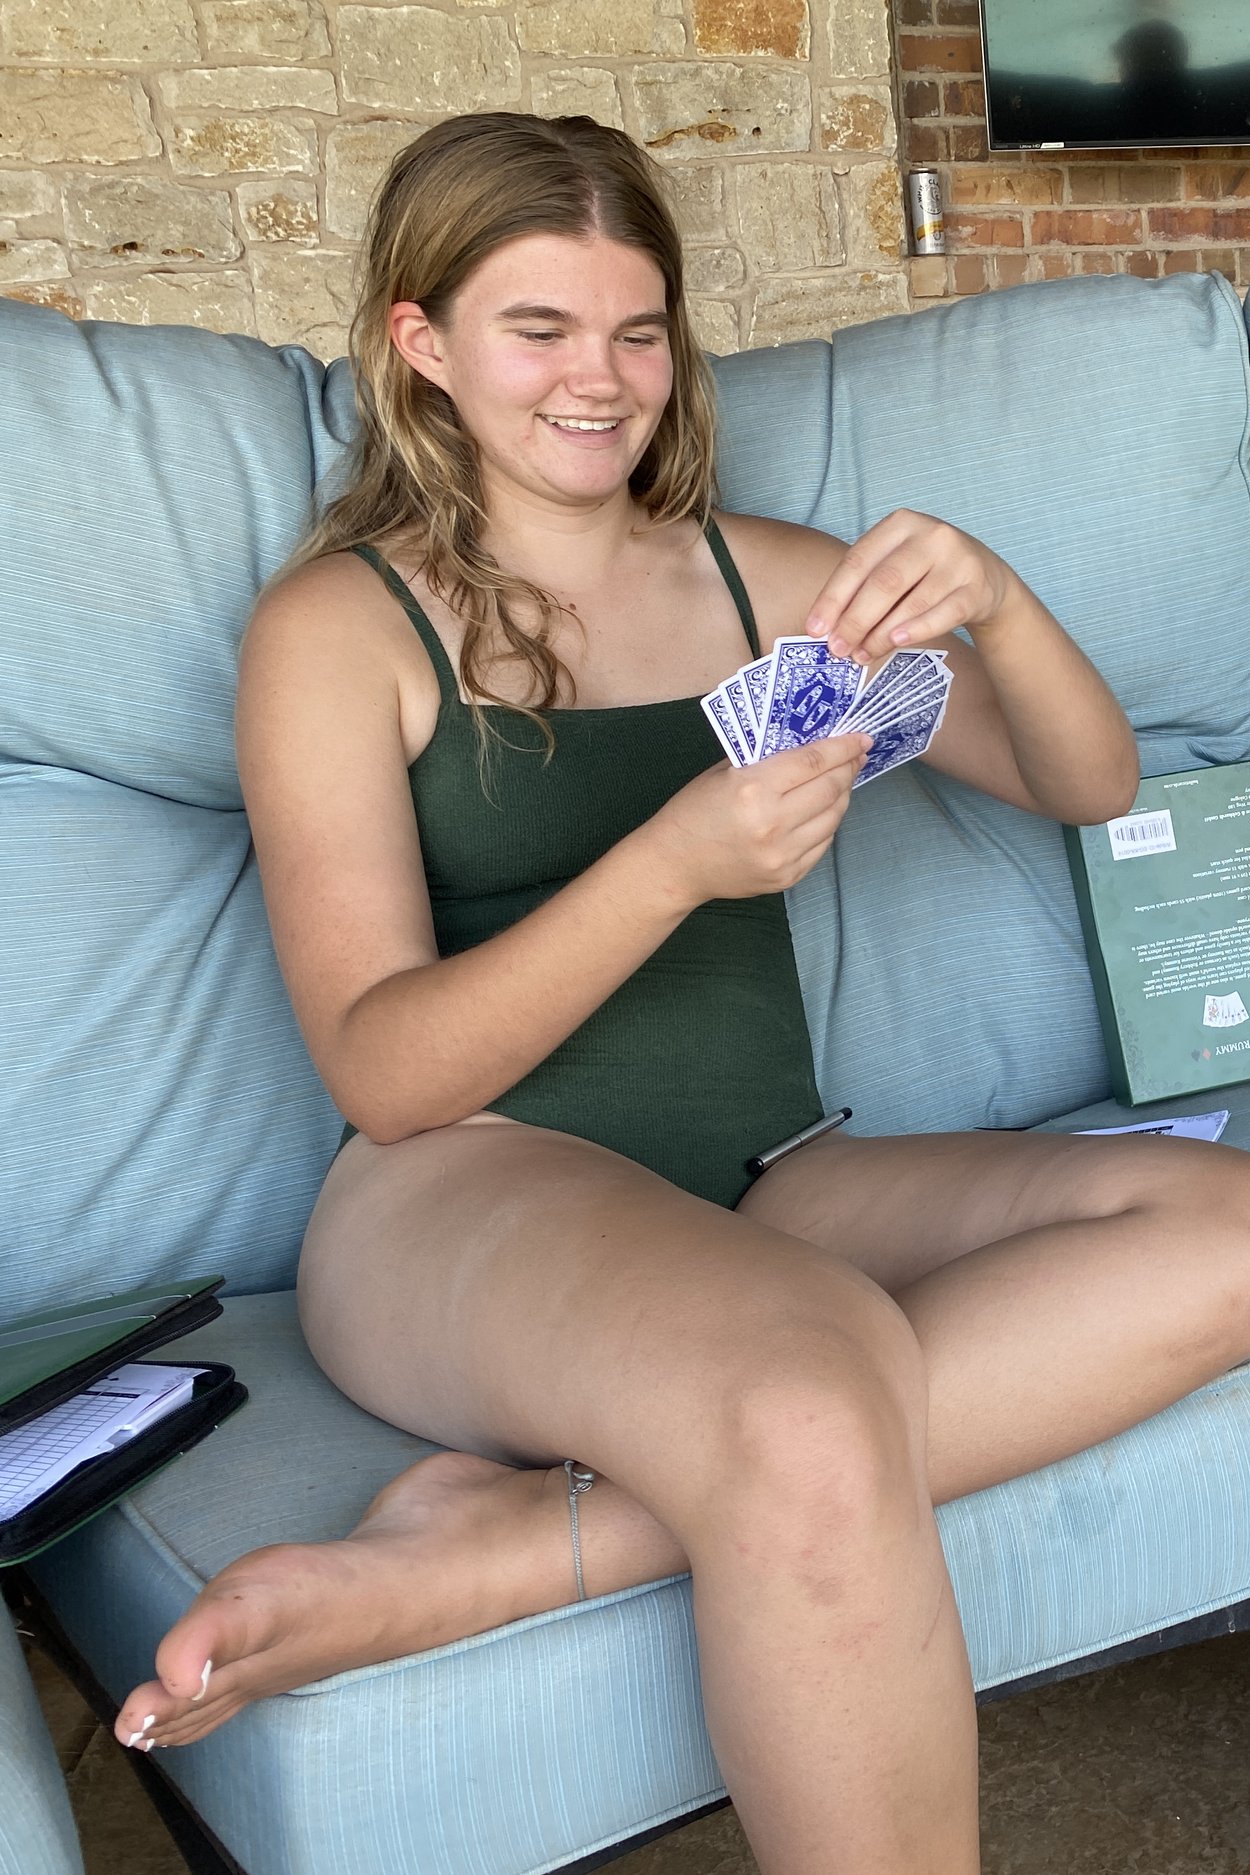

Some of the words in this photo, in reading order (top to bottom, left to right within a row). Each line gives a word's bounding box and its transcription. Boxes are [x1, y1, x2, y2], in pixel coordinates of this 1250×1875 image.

[1224, 960, 1241, 970] explain
[1227, 966, 1243, 975] players
[1162, 979, 1179, 988] playing
[1214, 1039, 1250, 1055] RUMMY
